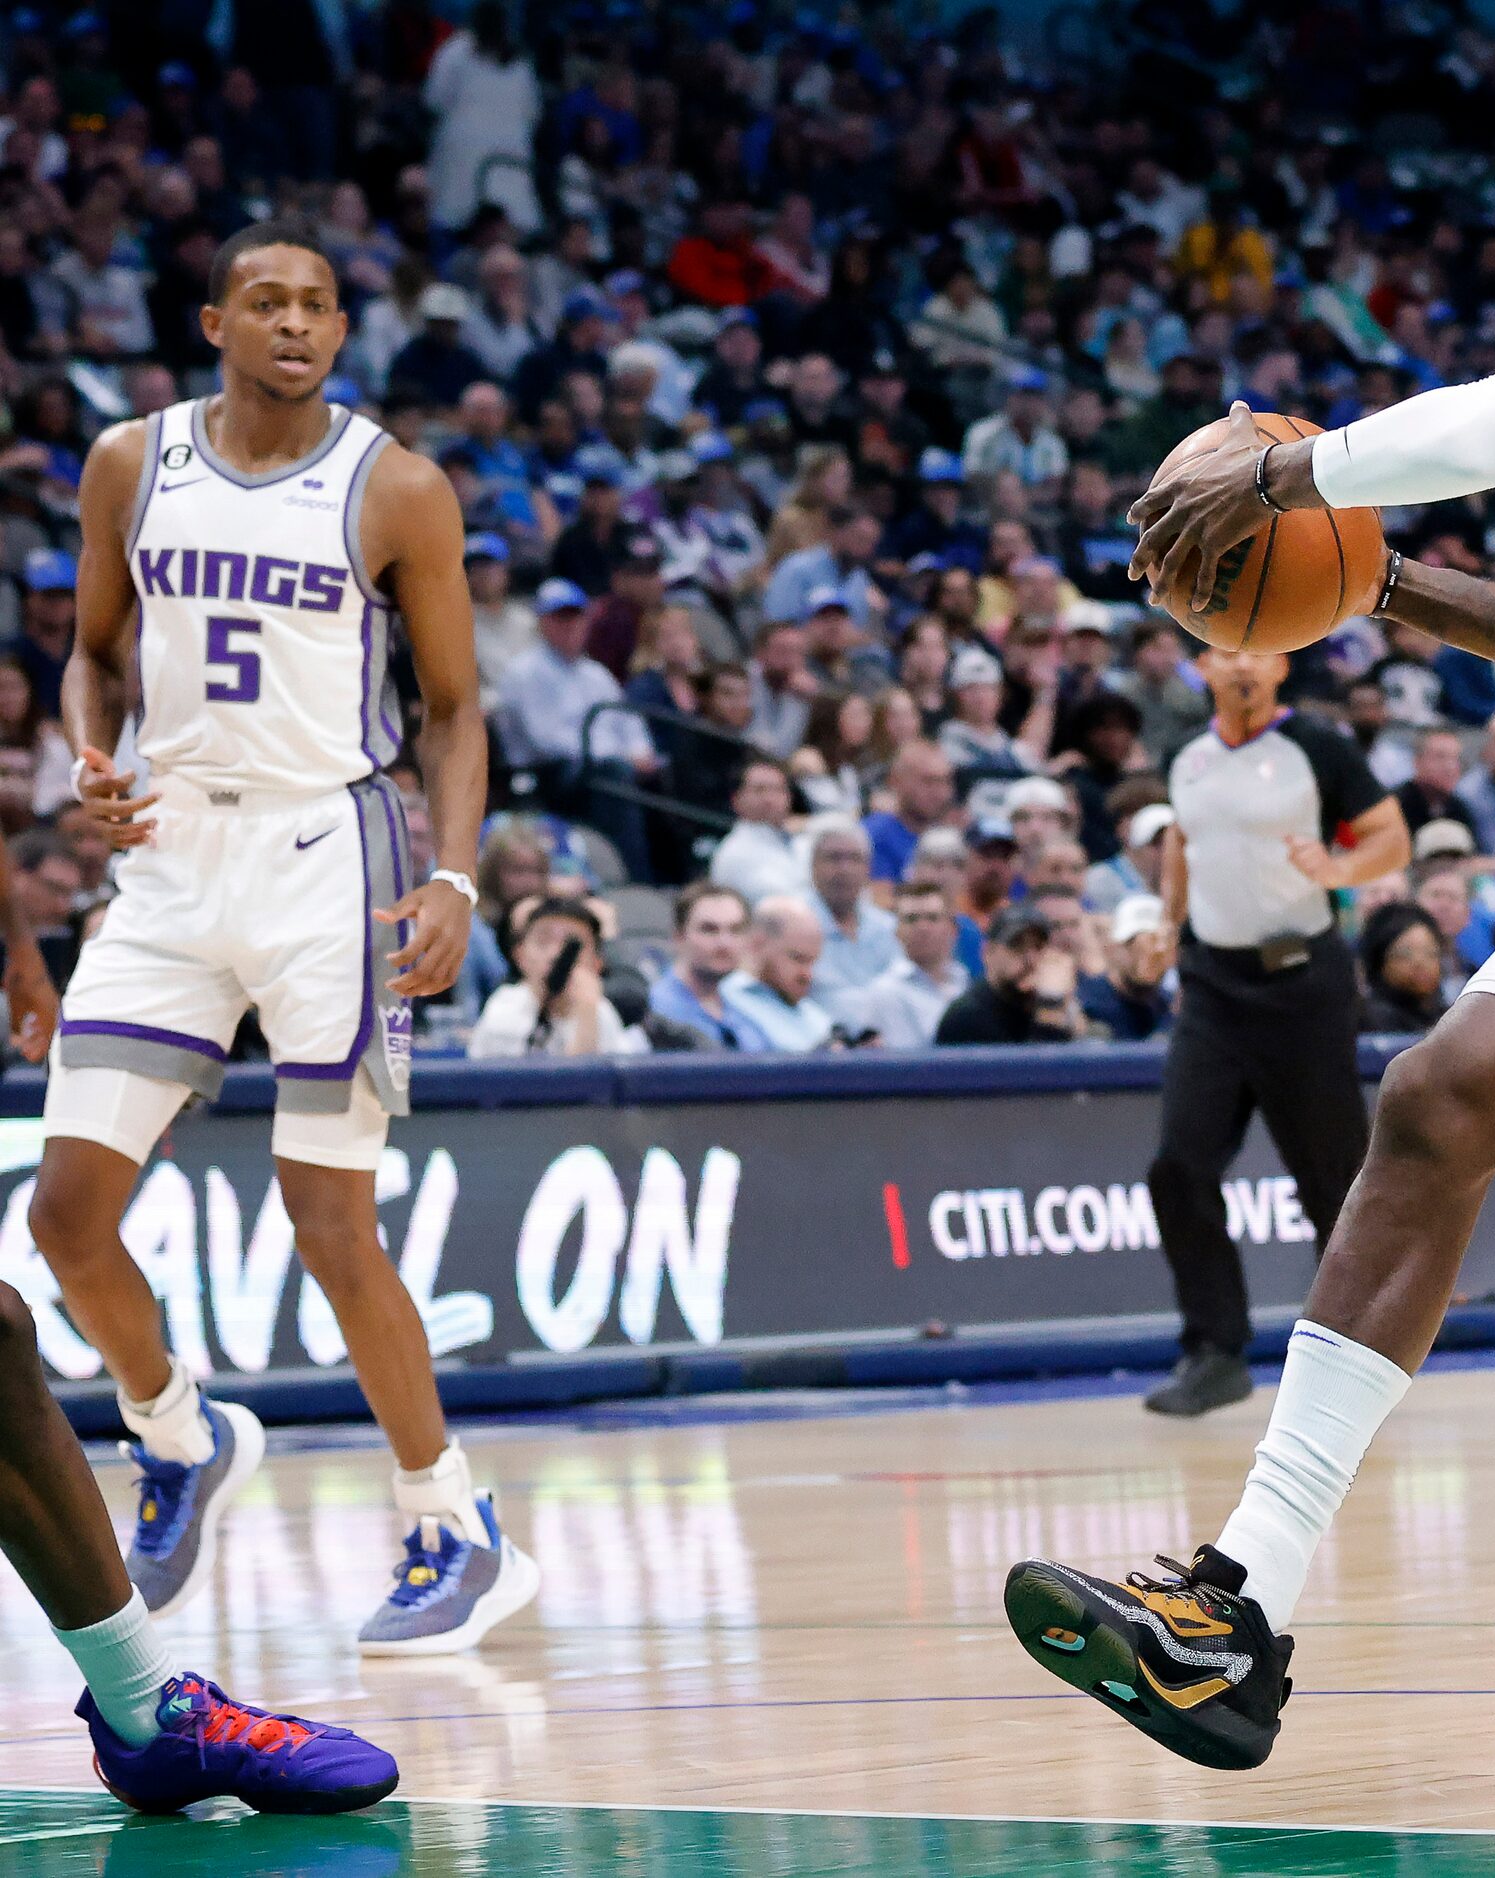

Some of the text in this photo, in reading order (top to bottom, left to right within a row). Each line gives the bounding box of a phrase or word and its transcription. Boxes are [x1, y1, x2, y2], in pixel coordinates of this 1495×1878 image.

[163, 443, 192, 471] 6
[138, 548, 349, 615] KINGS
[205, 615, 263, 705] 5
[515, 1145, 742, 1353] ON
[928, 1184, 1161, 1260] CITI.COM
